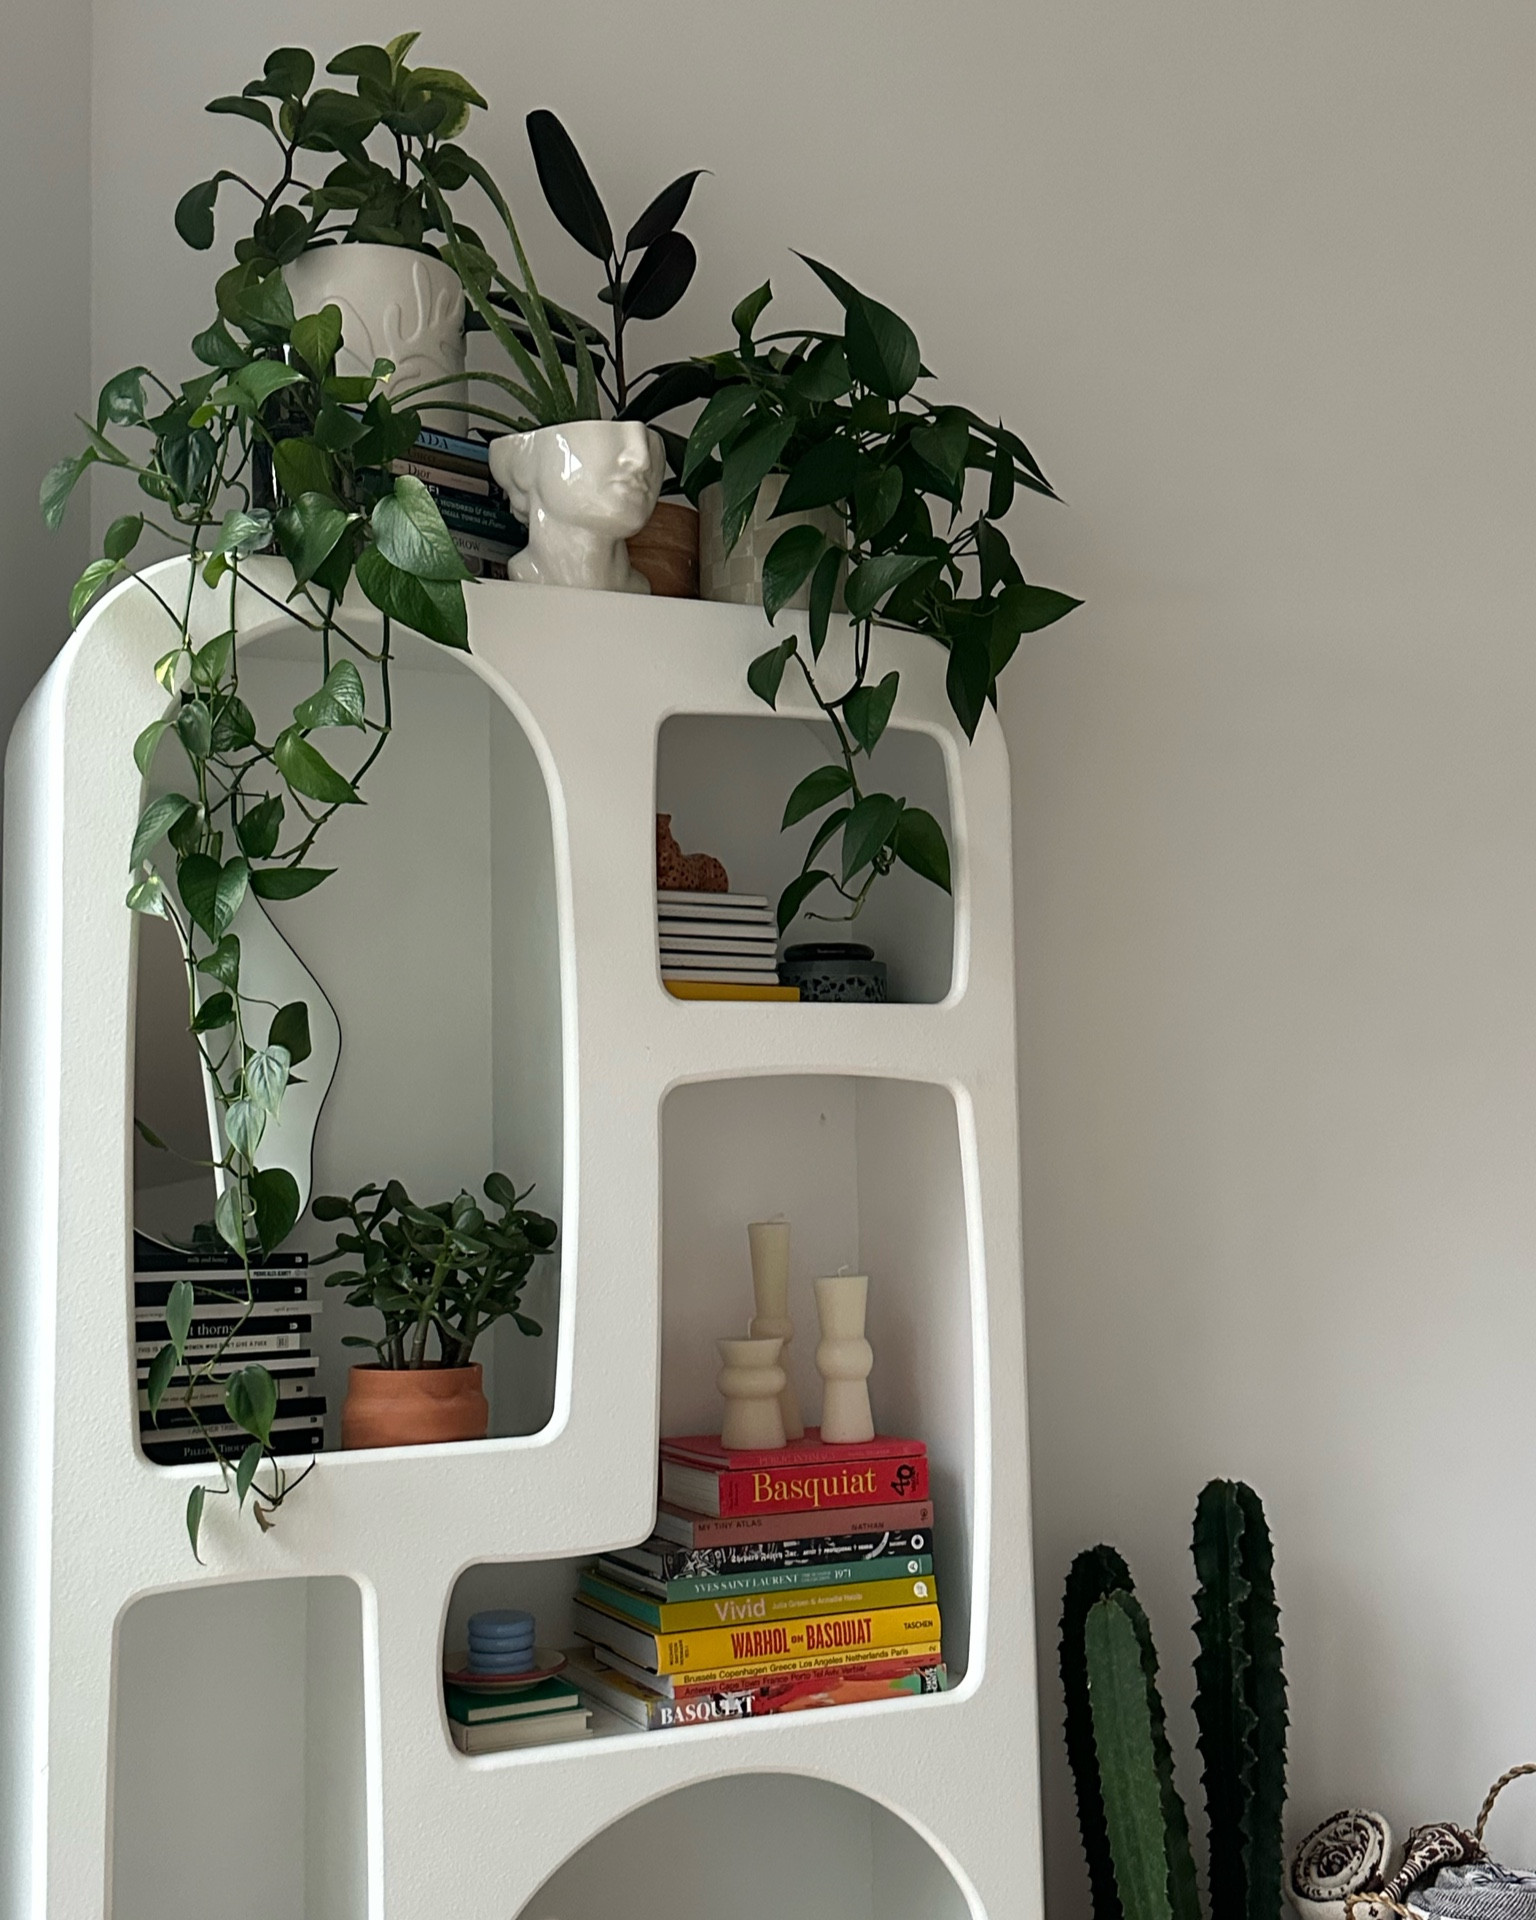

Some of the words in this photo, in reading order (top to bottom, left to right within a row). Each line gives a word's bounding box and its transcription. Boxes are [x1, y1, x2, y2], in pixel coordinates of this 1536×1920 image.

[417, 433, 449, 449] ADA
[408, 464, 432, 479] Dior
[752, 1467, 877, 1508] Basquiat
[698, 1524, 710, 1532] MY
[714, 1520, 734, 1531] TINY
[736, 1518, 763, 1529] ATLAS
[851, 1521, 885, 1531] NATHAN
[694, 1582, 719, 1593] YVES
[720, 1578, 749, 1590] SAINT
[752, 1573, 798, 1588] LAURENT
[714, 1597, 767, 1622] Vivid
[903, 1620, 934, 1631] TASCHEN
[731, 1627, 791, 1660] WARHOL
[791, 1634, 804, 1644] ON
[806, 1618, 872, 1651] BASQUIAT
[683, 1673, 717, 1684] Brussels
[718, 1666, 769, 1681] Copenhagen
[769, 1663, 796, 1673] Greece
[798, 1660, 812, 1669] Los
[813, 1656, 843, 1669] Angeles
[845, 1651, 889, 1664] Netherlands
[890, 1648, 909, 1658] Paris
[684, 1684, 718, 1697] Antwerp
[719, 1681, 740, 1692] Cape
[741, 1678, 761, 1688] Town
[762, 1675, 790, 1686] France
[790, 1671, 812, 1683] Porto
[660, 1694, 756, 1726] BASQUIAT
